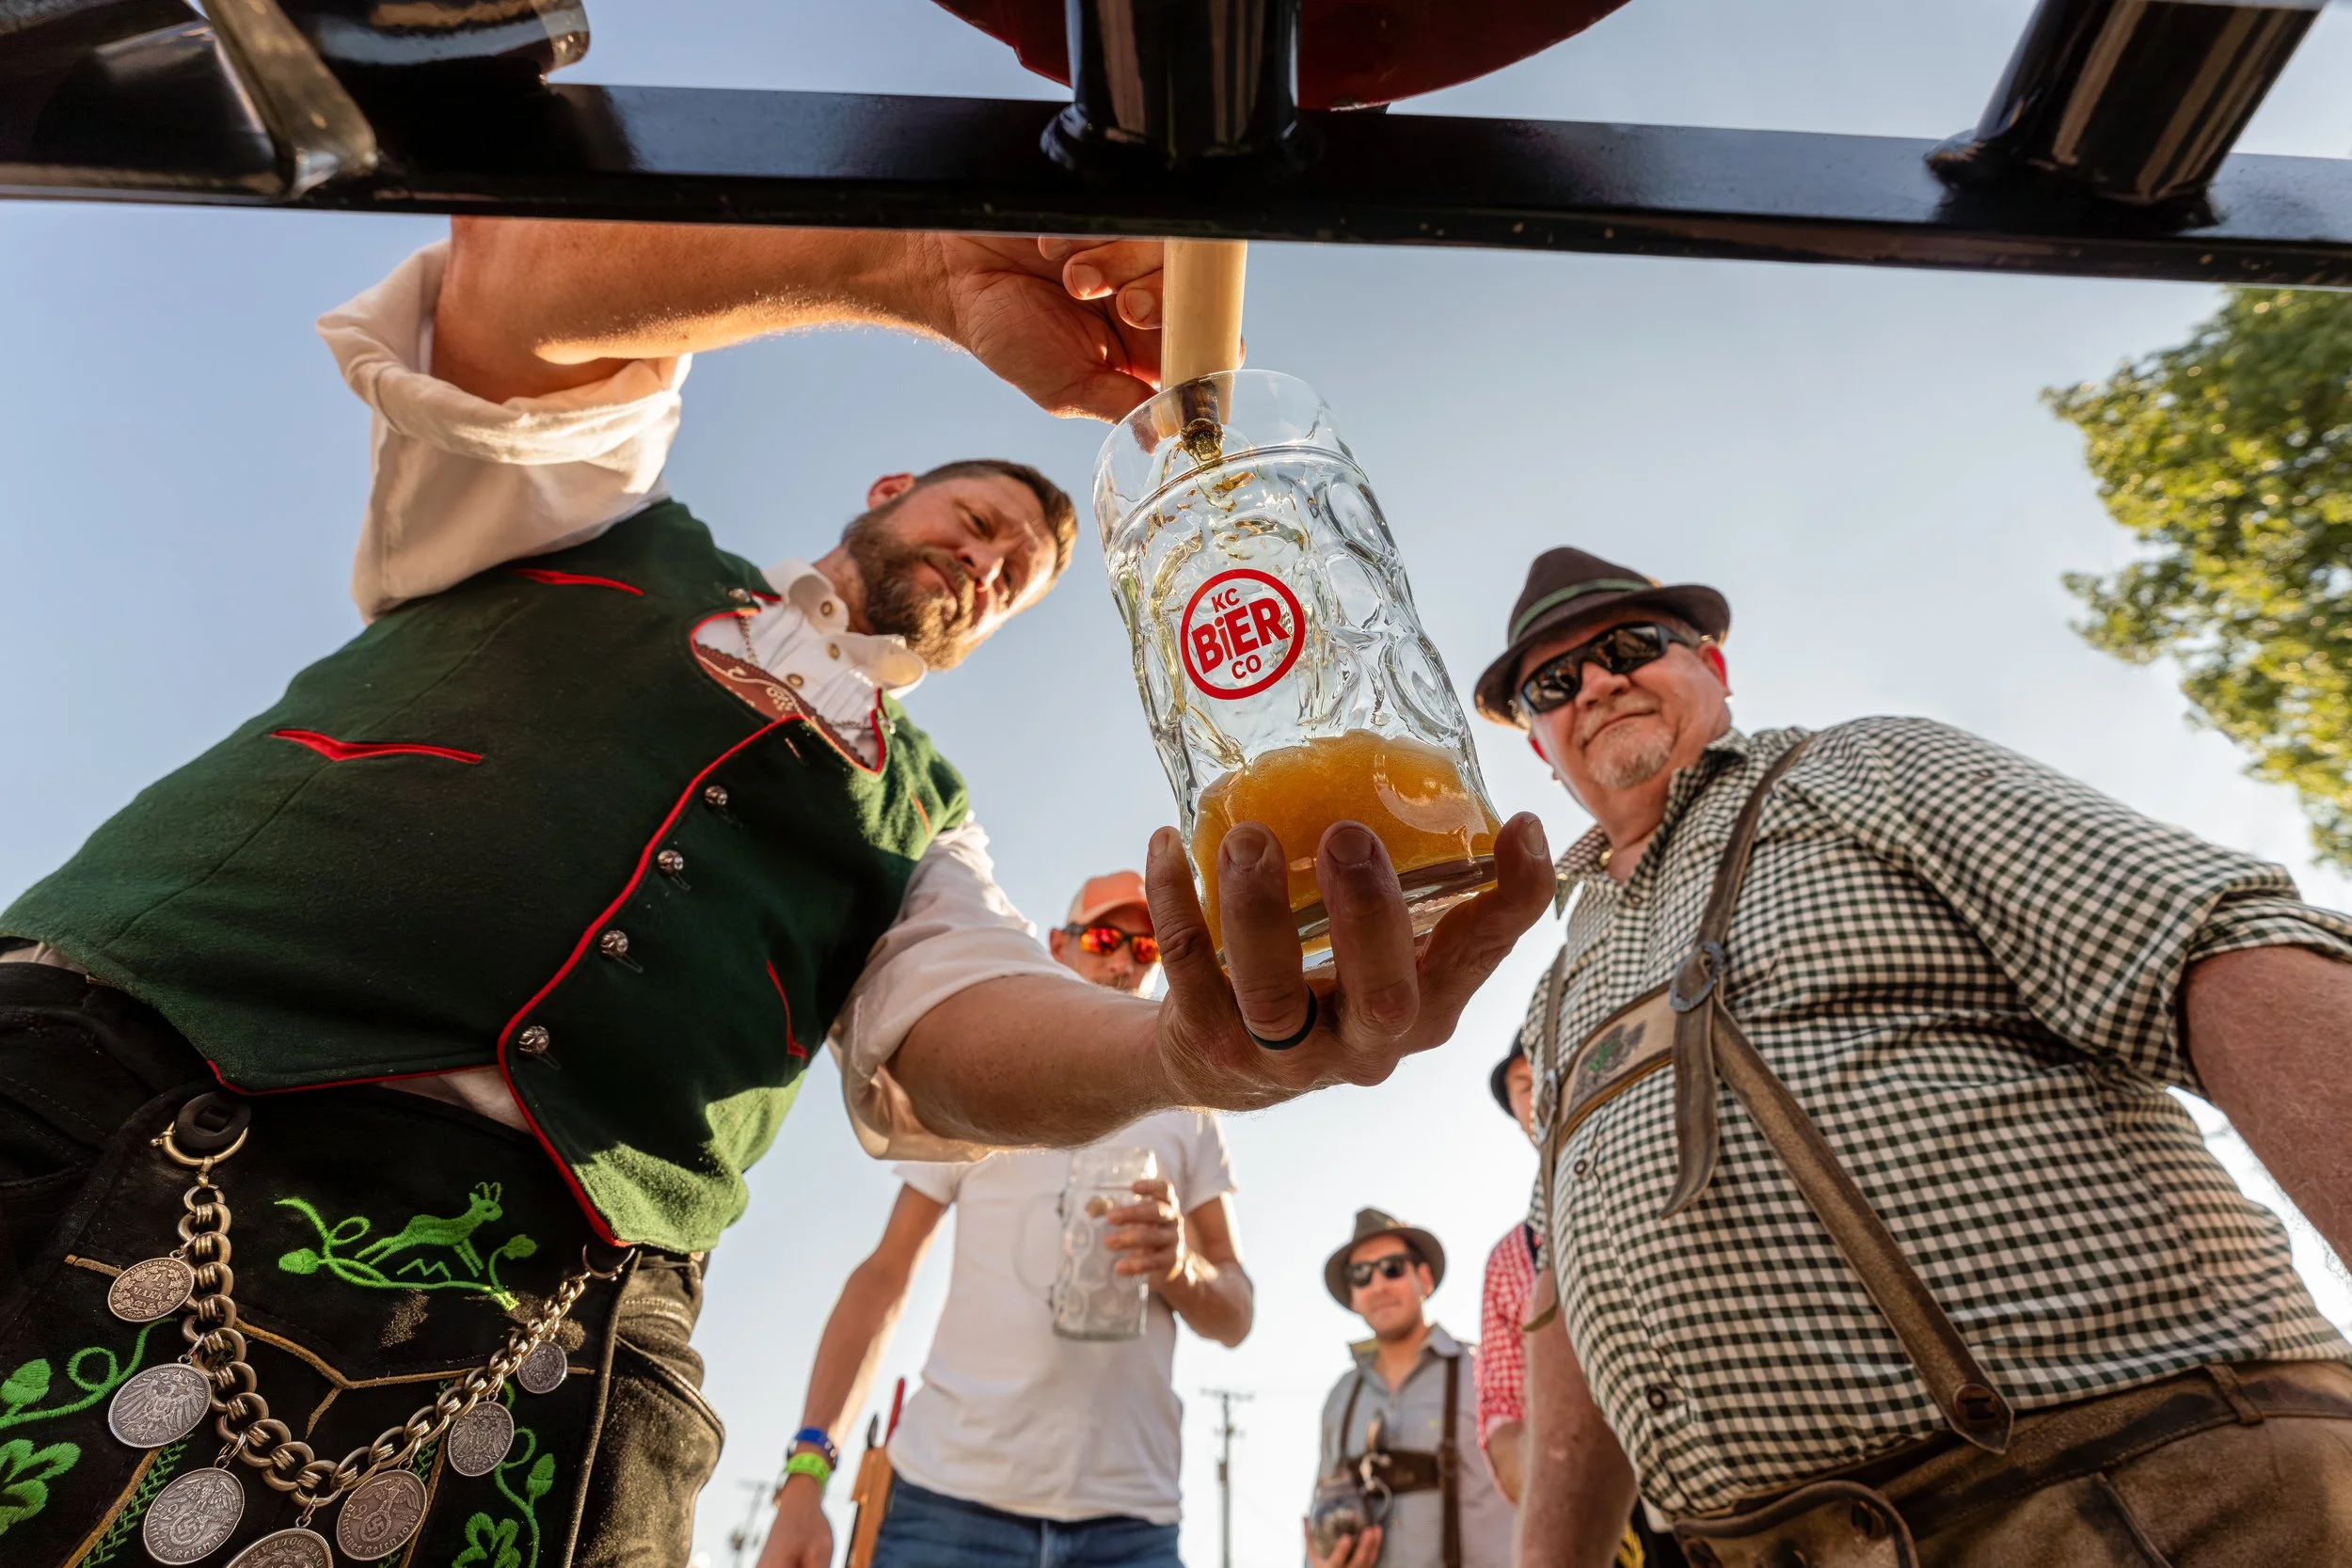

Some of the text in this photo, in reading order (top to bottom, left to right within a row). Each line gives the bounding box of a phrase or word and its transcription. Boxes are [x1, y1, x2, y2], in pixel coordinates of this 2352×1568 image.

[1211, 588, 1240, 613] KC
[1232, 655, 1262, 679] CO
[131, 1287, 169, 1300] MARK
